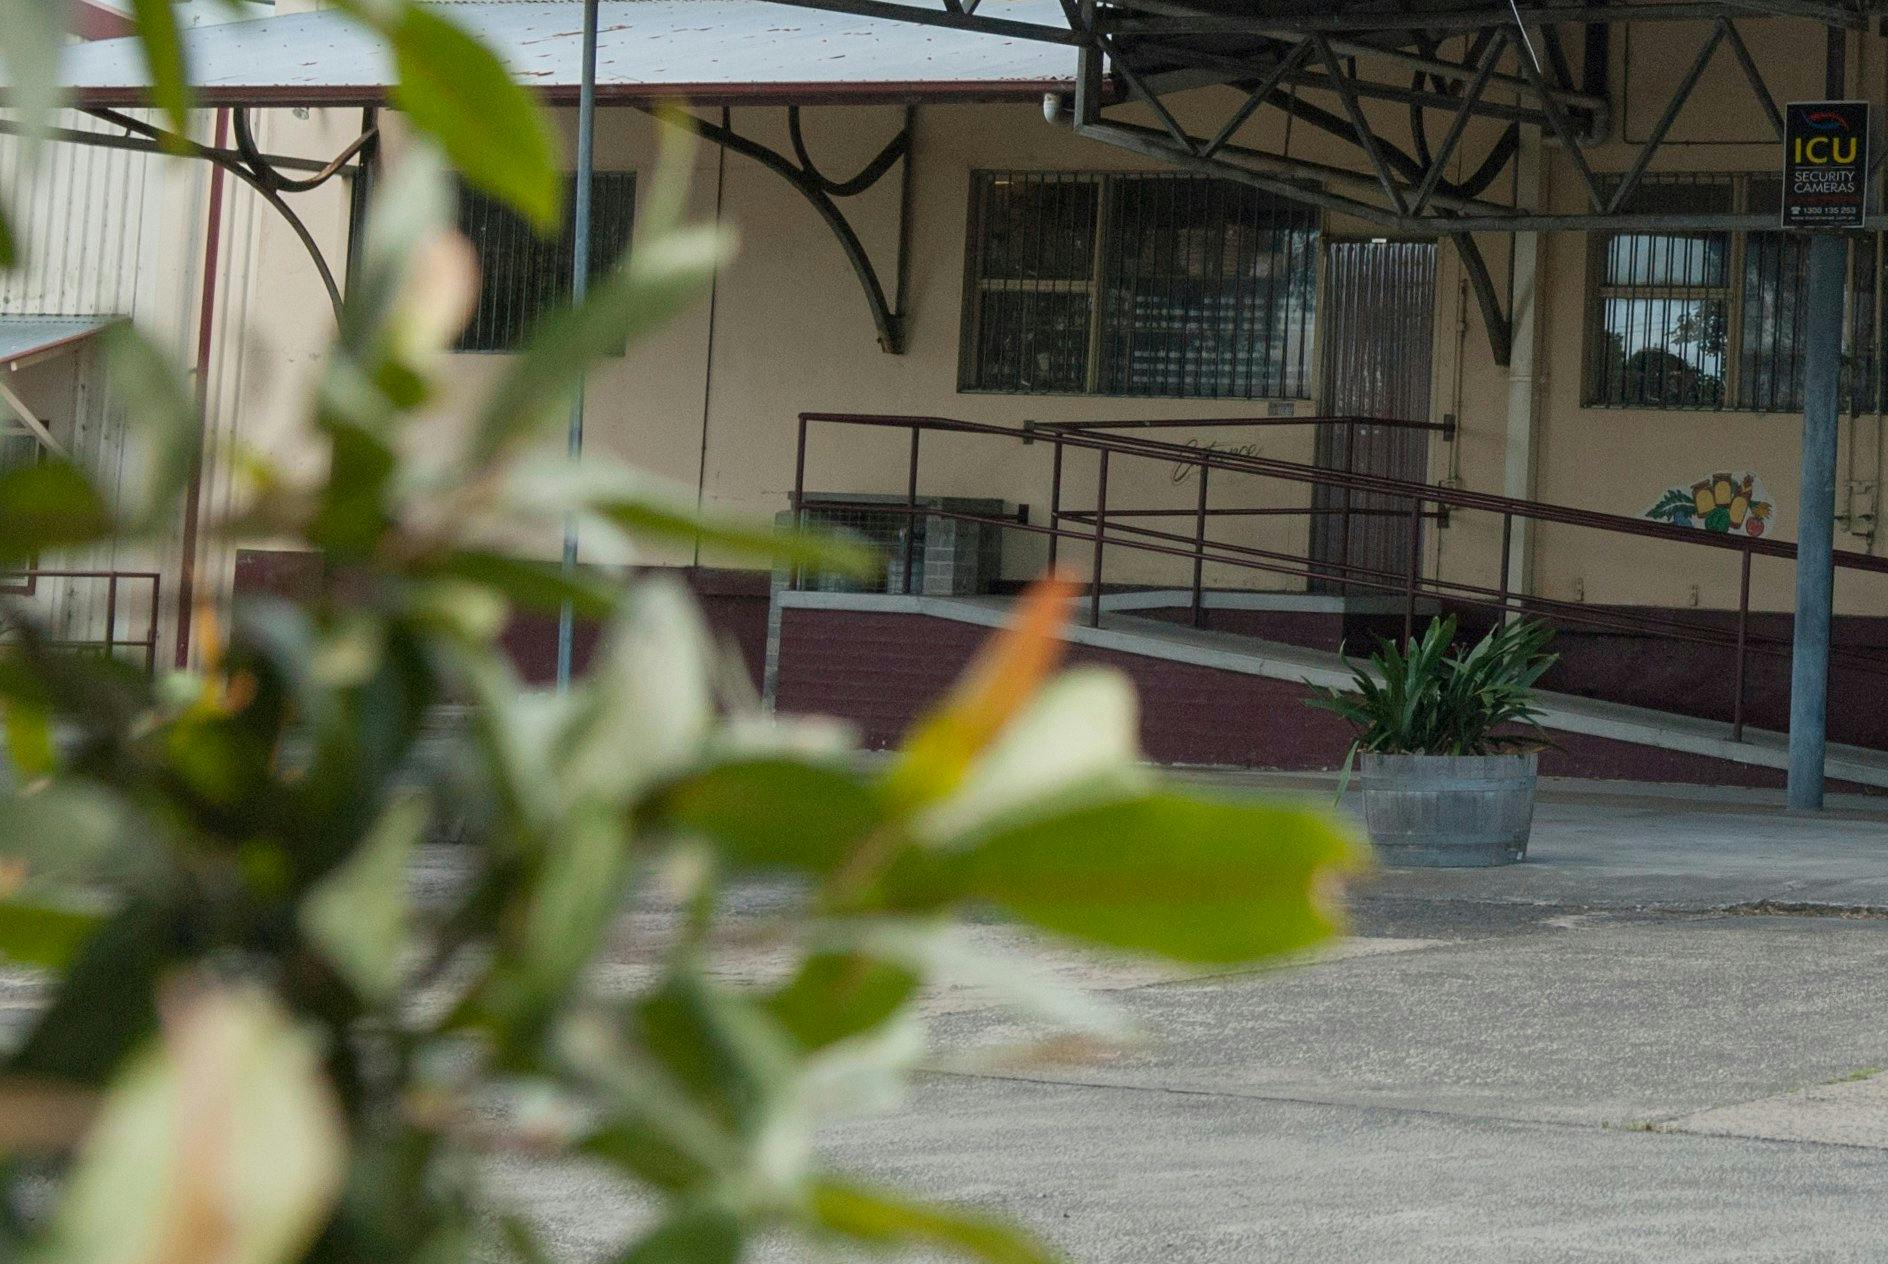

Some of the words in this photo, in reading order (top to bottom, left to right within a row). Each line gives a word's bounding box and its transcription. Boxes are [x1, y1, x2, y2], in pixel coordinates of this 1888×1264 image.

[1794, 136, 1858, 165] ICU
[1794, 171, 1856, 183] SECURITY
[1794, 182, 1855, 194] CAMERAS
